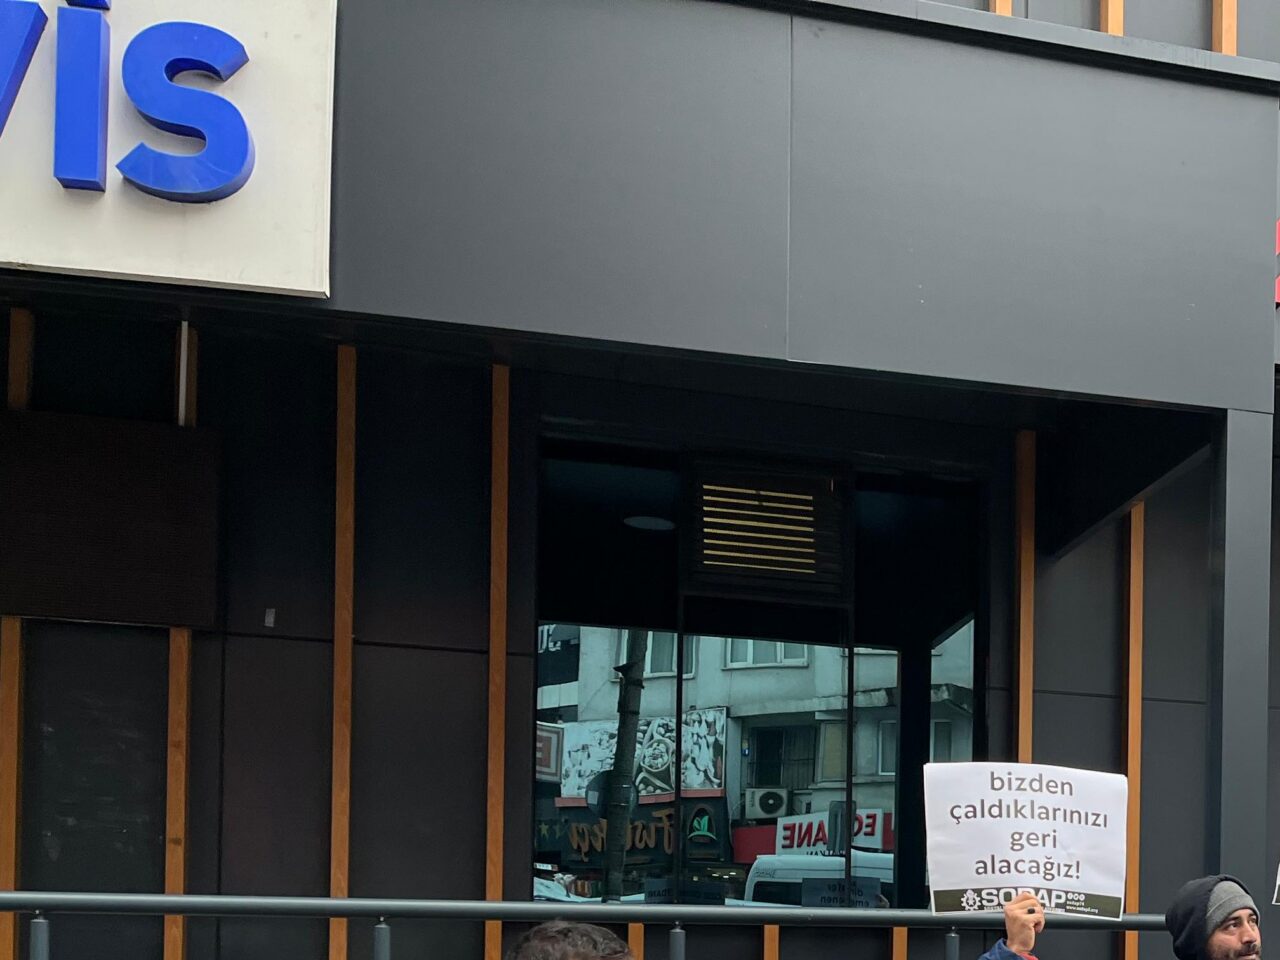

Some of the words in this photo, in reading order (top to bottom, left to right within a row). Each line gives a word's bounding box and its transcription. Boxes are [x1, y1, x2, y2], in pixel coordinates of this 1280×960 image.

[990, 771, 1073, 796] bizden
[950, 799, 1108, 828] çaldıklarınızı
[1010, 830, 1057, 852] geri
[975, 855, 1081, 881] alacağız!
[981, 888, 1066, 908] SOAP
